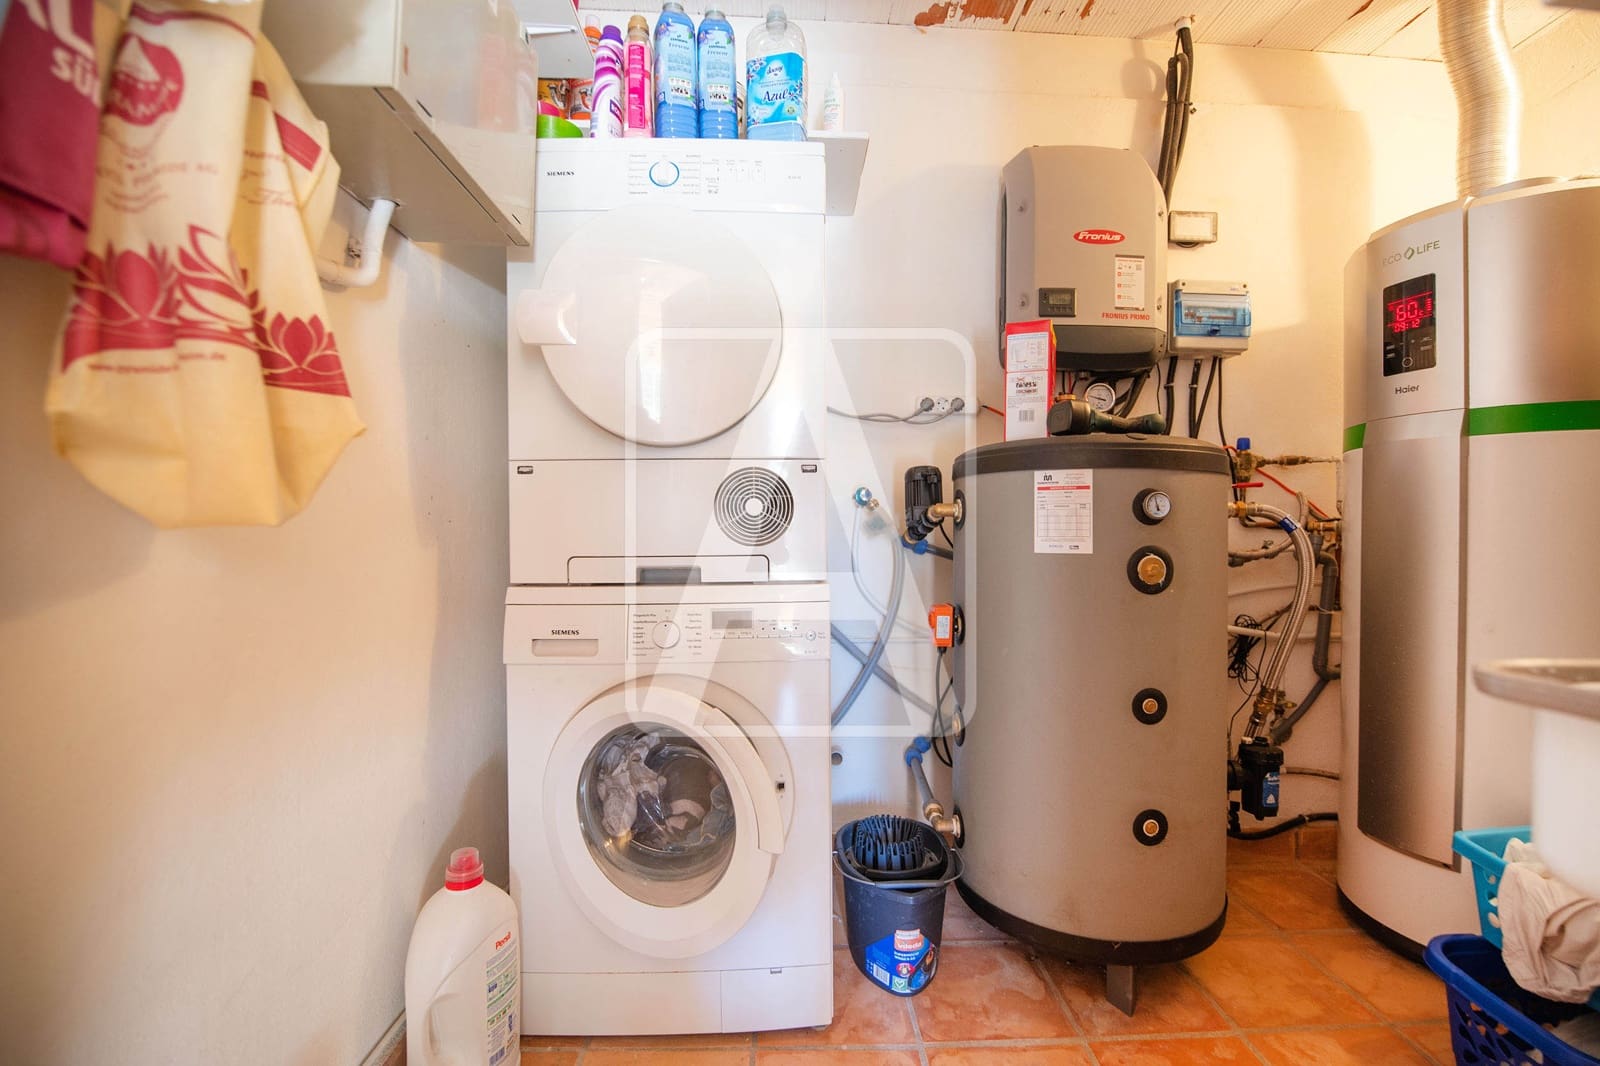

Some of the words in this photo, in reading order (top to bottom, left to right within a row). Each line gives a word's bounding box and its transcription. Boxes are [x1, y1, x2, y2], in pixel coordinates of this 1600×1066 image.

[762, 88, 789, 102] Azul
[1077, 231, 1122, 241] Fronius
[1382, 253, 1402, 266] ECO
[1416, 240, 1441, 255] LIFE
[1101, 312, 1129, 320] FRONIUS
[1130, 313, 1151, 321] PRIMO
[1396, 301, 1419, 321] 60
[1394, 384, 1420, 395] Haier
